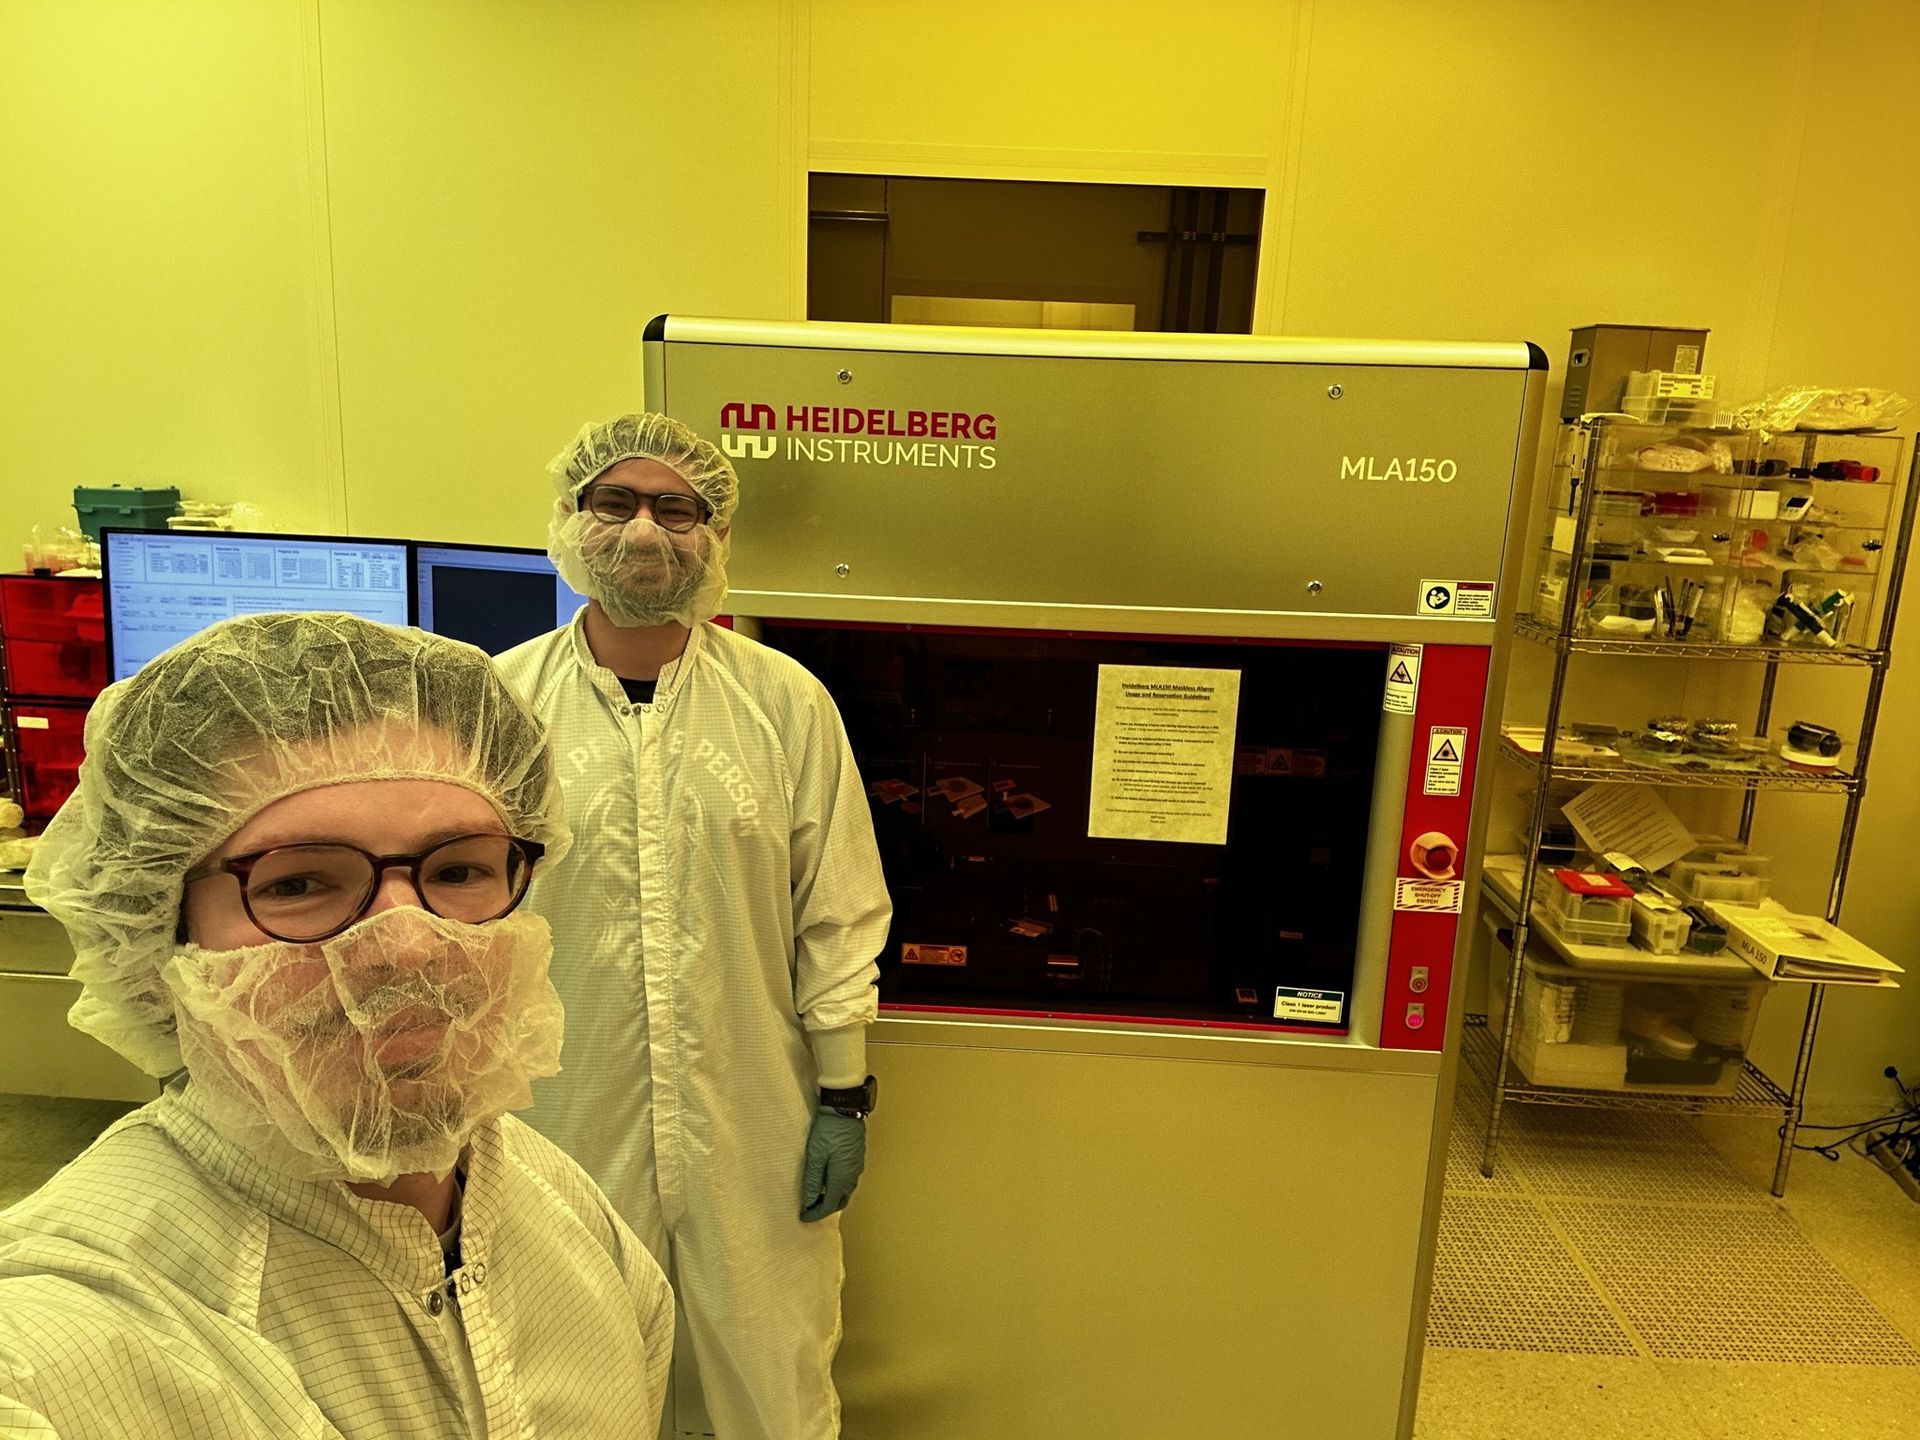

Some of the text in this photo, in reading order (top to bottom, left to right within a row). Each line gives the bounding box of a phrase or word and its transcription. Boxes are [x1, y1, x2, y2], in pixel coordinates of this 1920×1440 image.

[786, 405, 997, 440] HEIDELBERG
[786, 437, 997, 470] INSTRUMENTS
[1340, 456, 1458, 483] MLA150
[1396, 647, 1419, 655] CAUTION
[1152, 692, 1183, 700] Reservation
[1742, 940, 1767, 964] MLA 150
[1296, 991, 1323, 999] NOTICE
